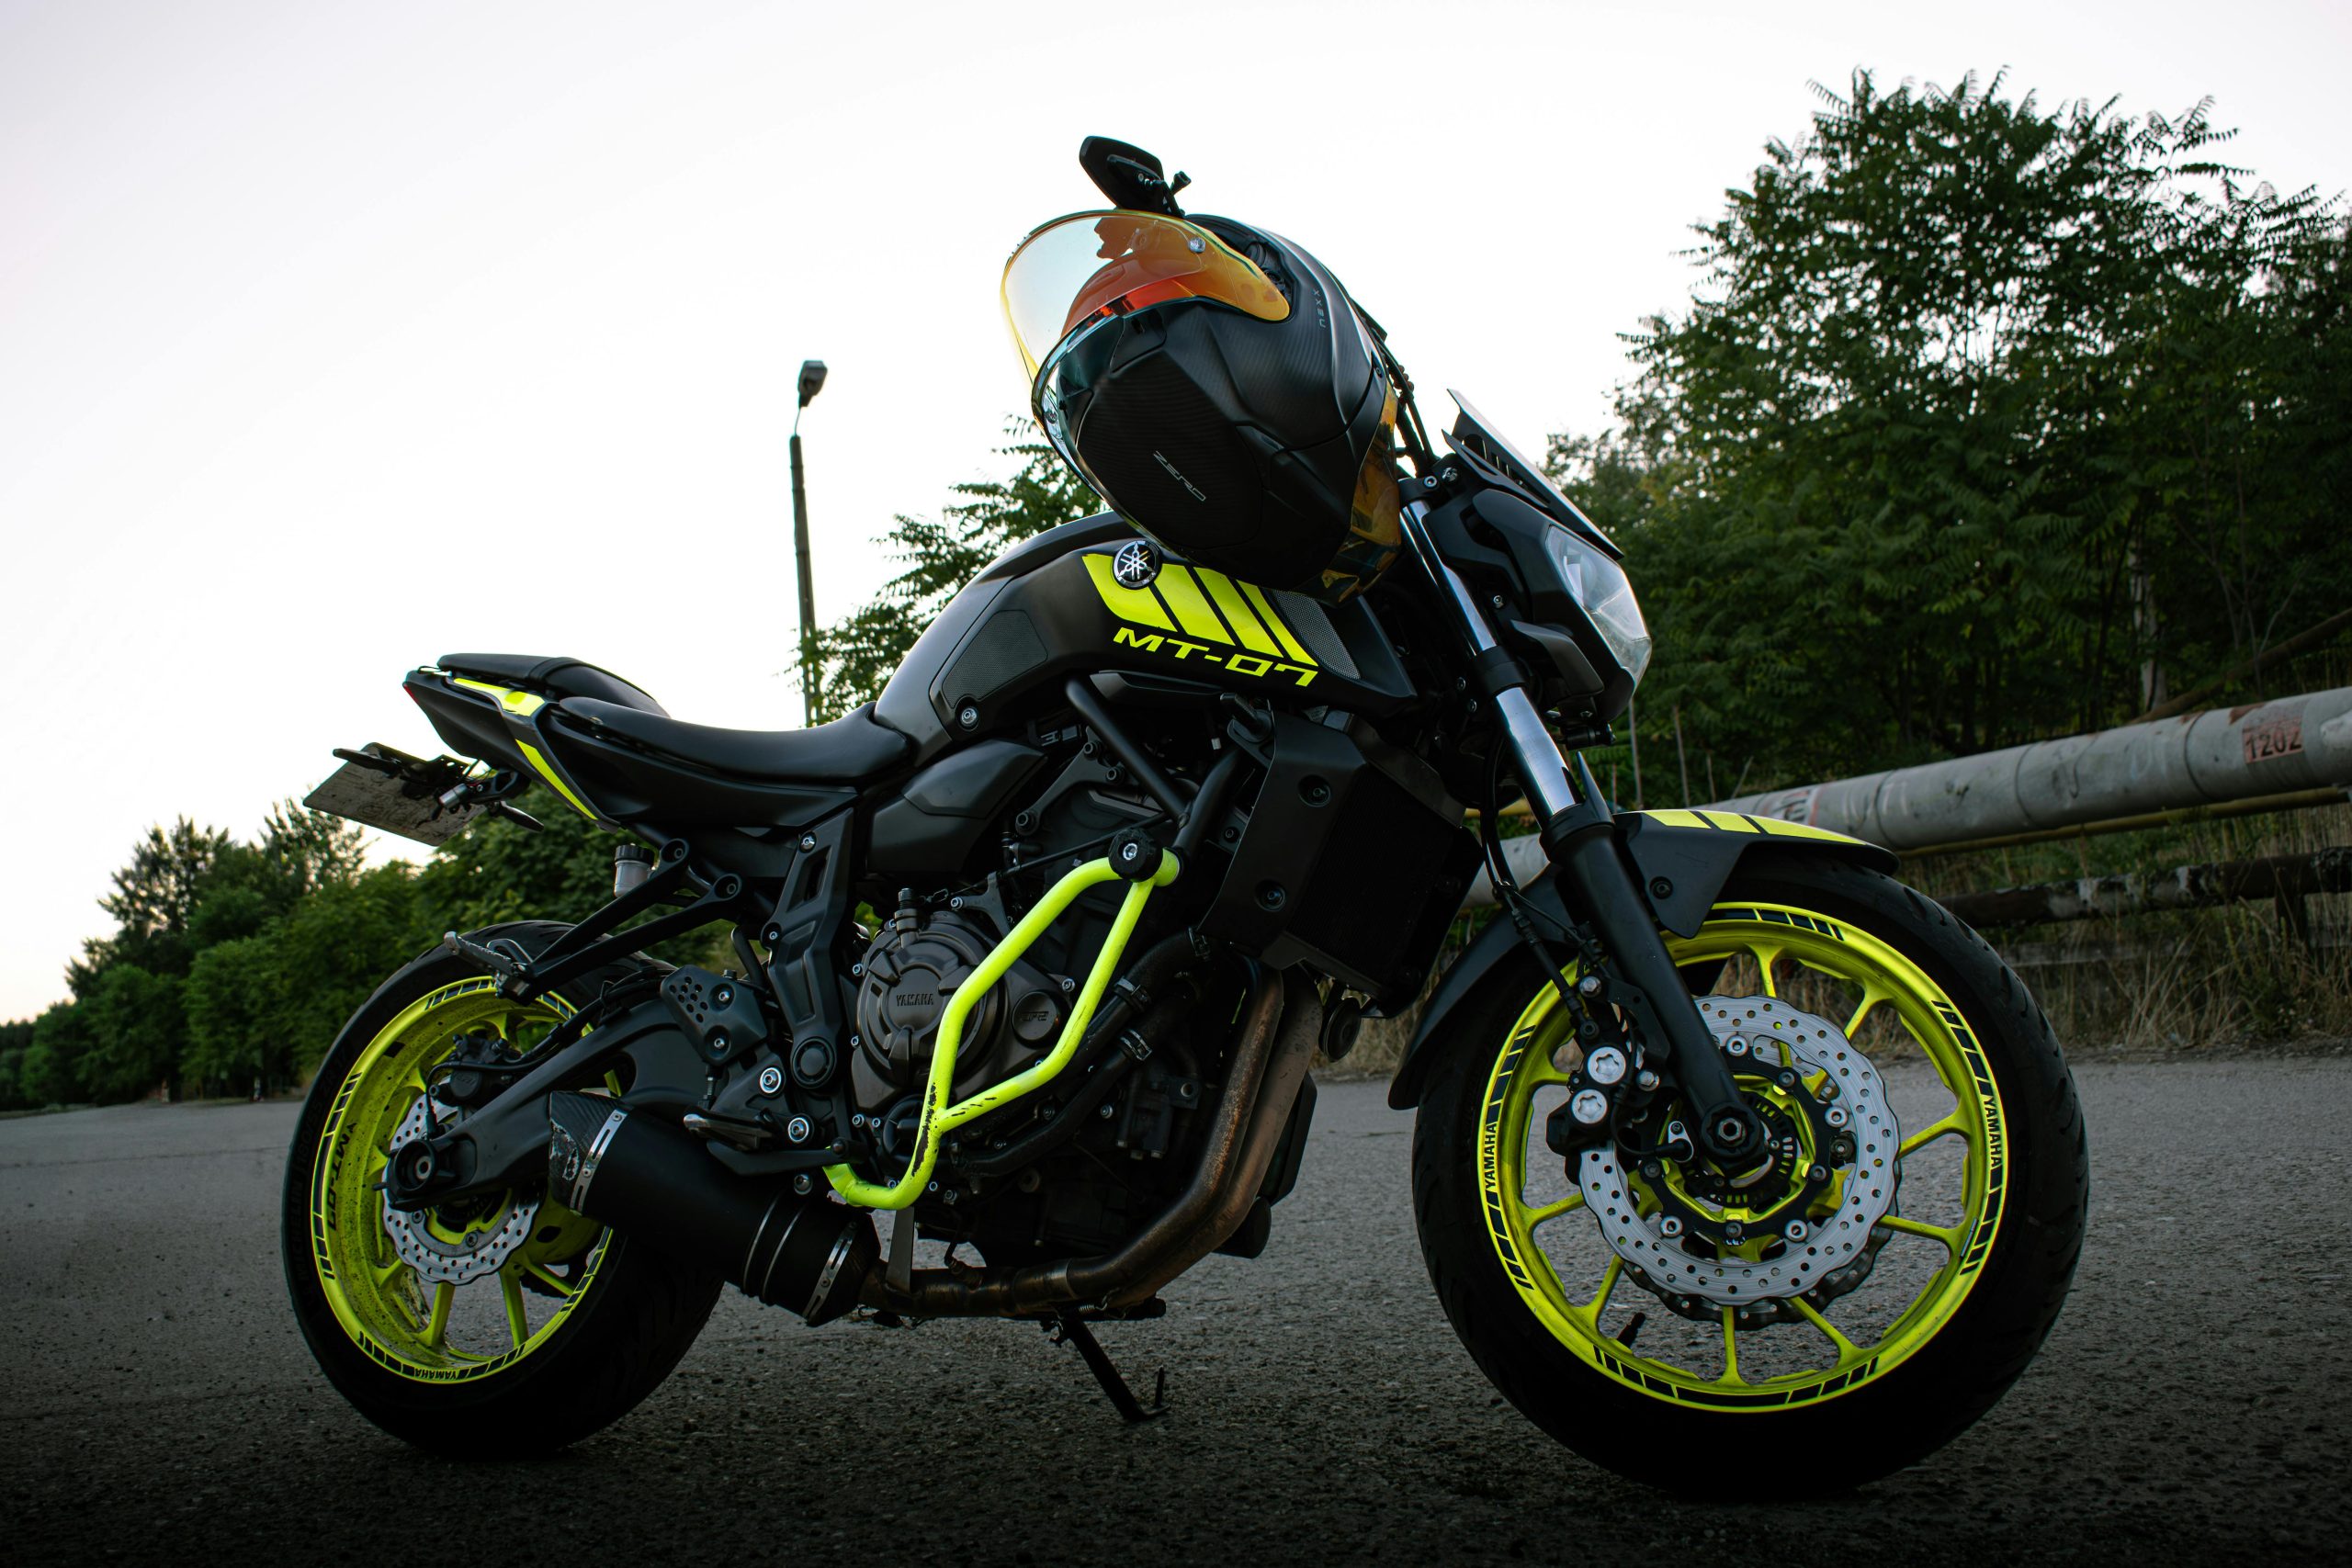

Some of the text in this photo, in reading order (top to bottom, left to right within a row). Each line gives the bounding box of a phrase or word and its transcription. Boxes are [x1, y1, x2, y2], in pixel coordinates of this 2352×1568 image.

[1152, 450, 1206, 502] ZERO
[1113, 627, 1318, 687] MT-07
[896, 993, 933, 1006] YAMAHA
[1485, 1123, 1497, 1189] YAMAHA
[1984, 1097, 2002, 1168] YAMAHA
[328, 1134, 350, 1230] MT-07
[289, 1180, 310, 1280] MICHELIN
[415, 1369, 457, 1380] YAMAHA
